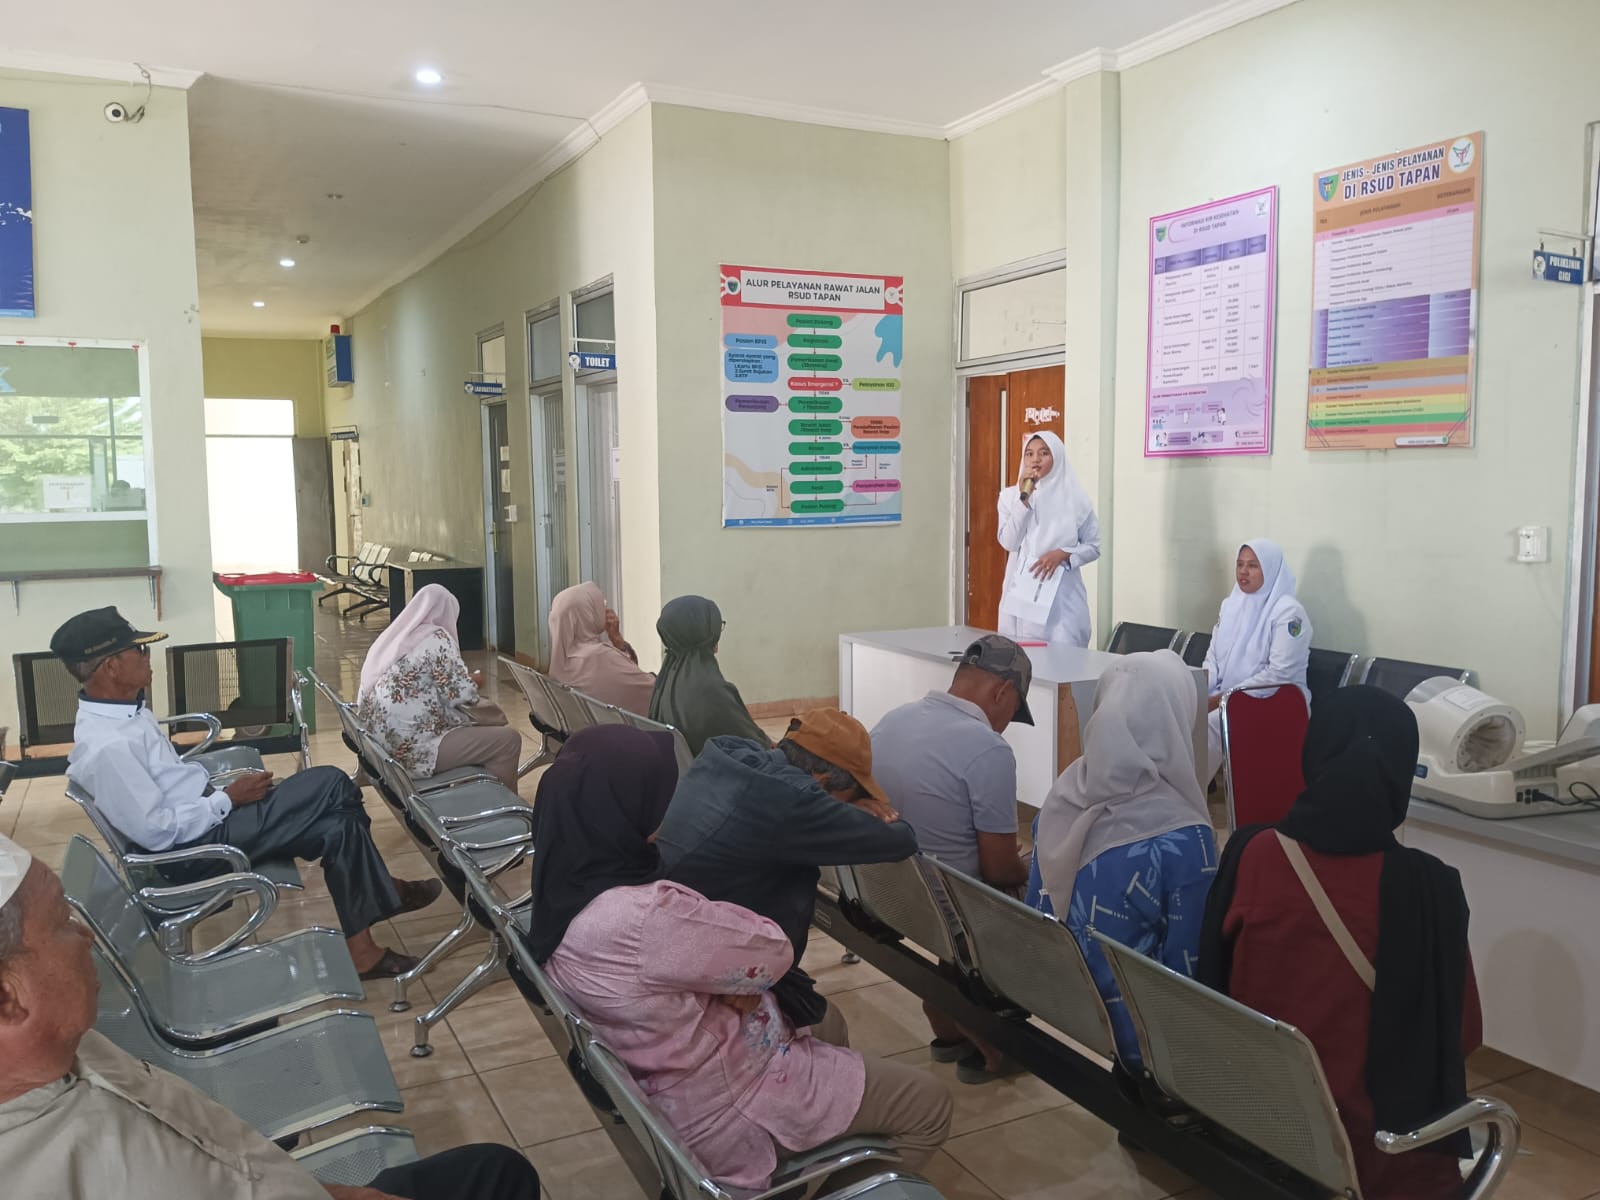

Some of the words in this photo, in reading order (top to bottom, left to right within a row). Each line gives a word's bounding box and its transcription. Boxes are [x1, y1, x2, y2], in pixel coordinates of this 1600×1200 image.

[1342, 167, 1364, 181] JENIS
[1372, 160, 1395, 175] JENIS
[1397, 147, 1445, 168] PELAYANAN
[1344, 182, 1356, 199] DI
[1361, 175, 1394, 196] RSUD
[1399, 164, 1441, 187] TAPAN
[1549, 255, 1581, 270] POLIKLINIK
[1558, 270, 1571, 281] GIGI
[746, 278, 769, 288] ALUR
[771, 280, 822, 291] PELAYANAN
[823, 284, 853, 293] RAWAT
[855, 285, 880, 294] JALAN
[788, 291, 811, 300] RSUD
[814, 292, 841, 301] TAPAN
[584, 356, 611, 367] TOILET
